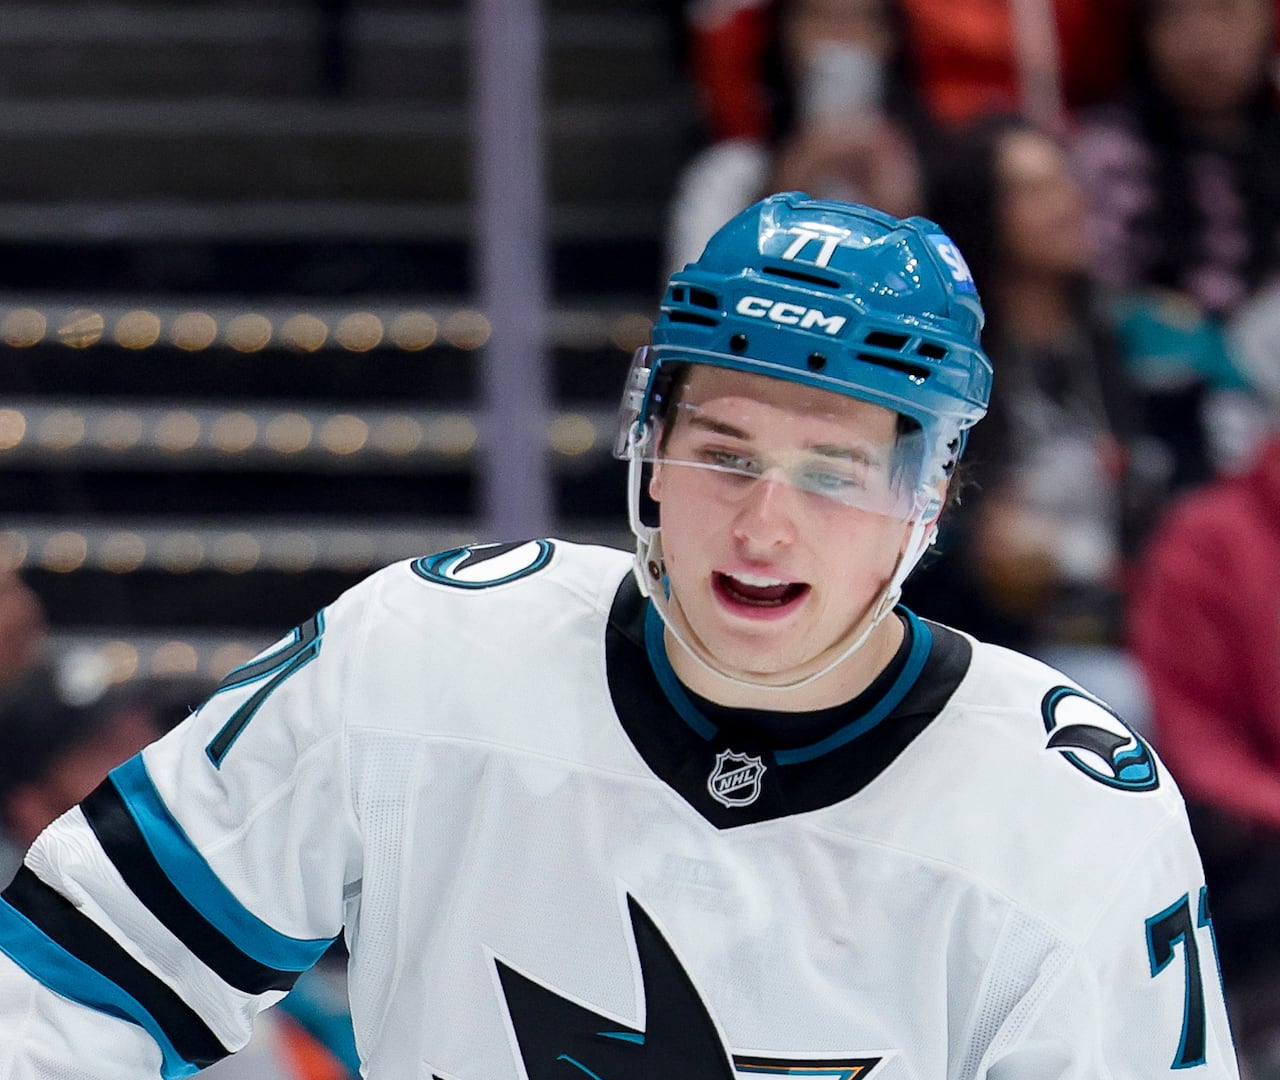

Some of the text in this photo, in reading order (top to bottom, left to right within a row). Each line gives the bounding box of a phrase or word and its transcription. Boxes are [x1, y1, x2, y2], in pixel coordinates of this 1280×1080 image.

[780, 226, 844, 269] 71
[735, 296, 847, 336] CCM
[719, 769, 754, 792] NHL
[1144, 884, 1228, 1070] 7
